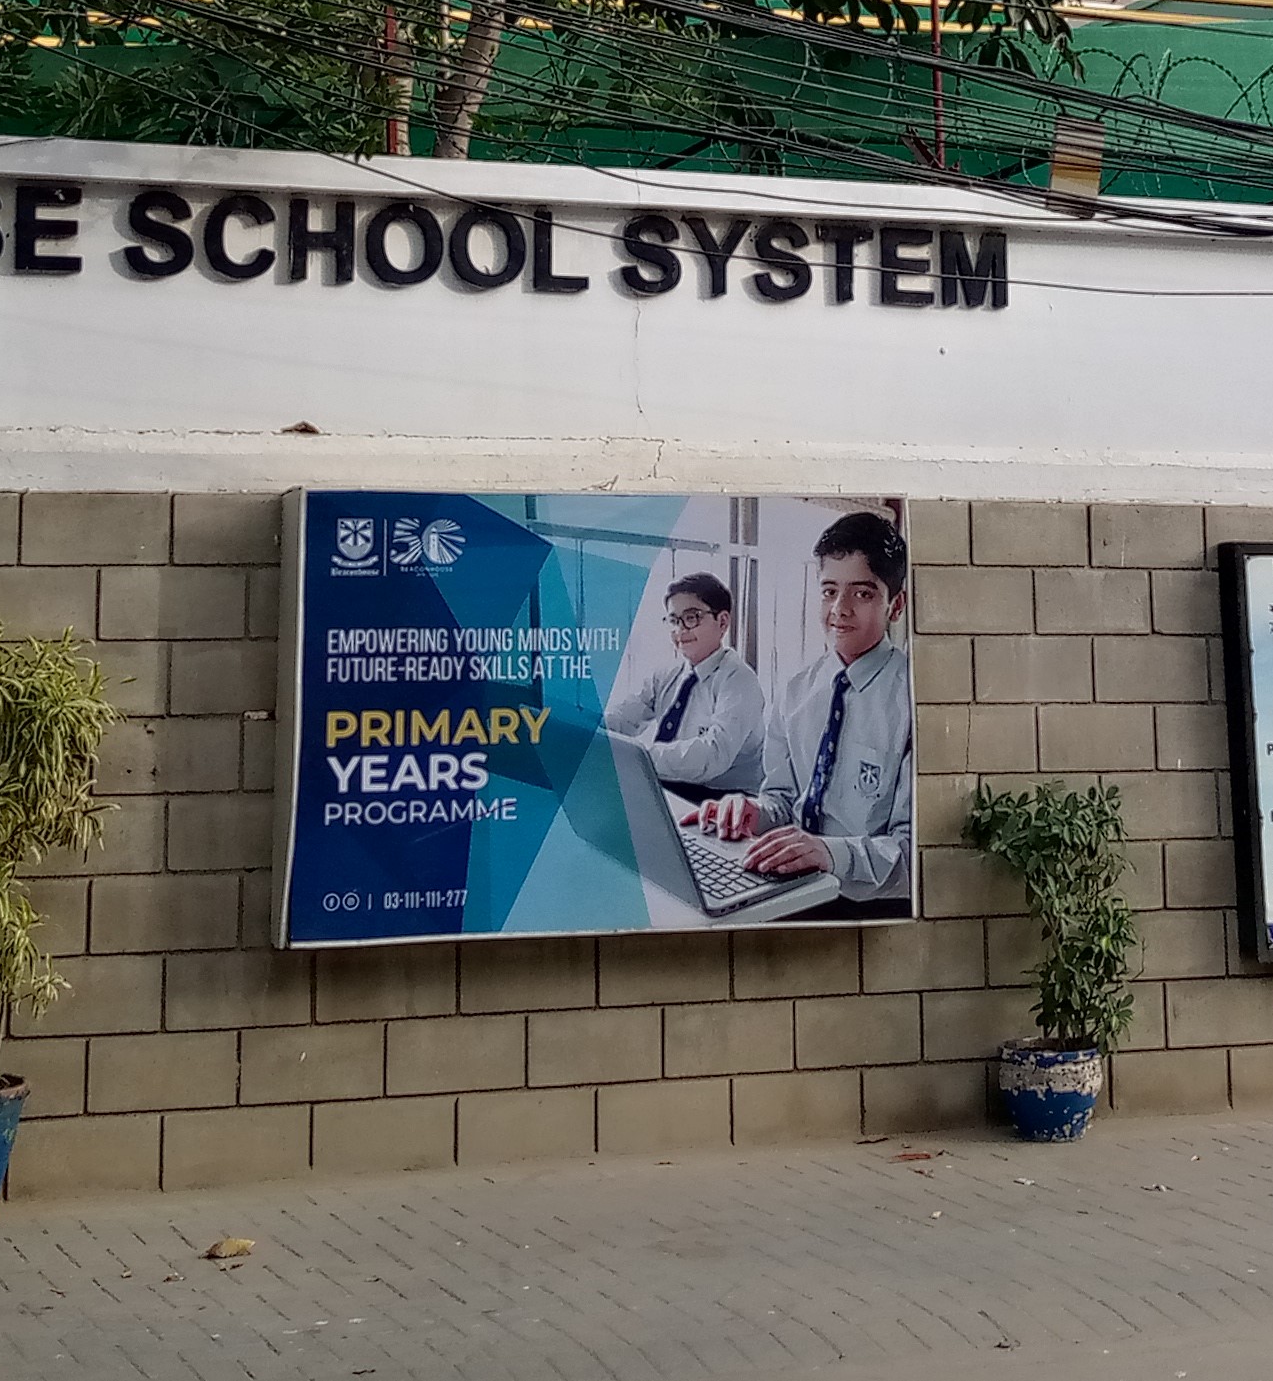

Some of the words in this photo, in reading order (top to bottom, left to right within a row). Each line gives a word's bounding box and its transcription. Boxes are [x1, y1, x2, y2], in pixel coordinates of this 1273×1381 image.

[126, 187, 589, 294] SCHOOL
[620, 214, 1010, 308] SYSTEM
[327, 627, 448, 654] EMPOWERING
[453, 627, 513, 653] YOUNG
[517, 627, 572, 652] MINDS
[576, 627, 620, 652] WITH
[327, 656, 466, 683] FUTURE-READY
[469, 655, 529, 681] SKILLS
[532, 656, 553, 680] AT
[559, 655, 592, 680] THE
[325, 706, 552, 749] PRIMARY
[327, 752, 490, 793] YEARS
[324, 797, 518, 826] PROGRAMME
[383, 889, 468, 910] 03-111-111-277
